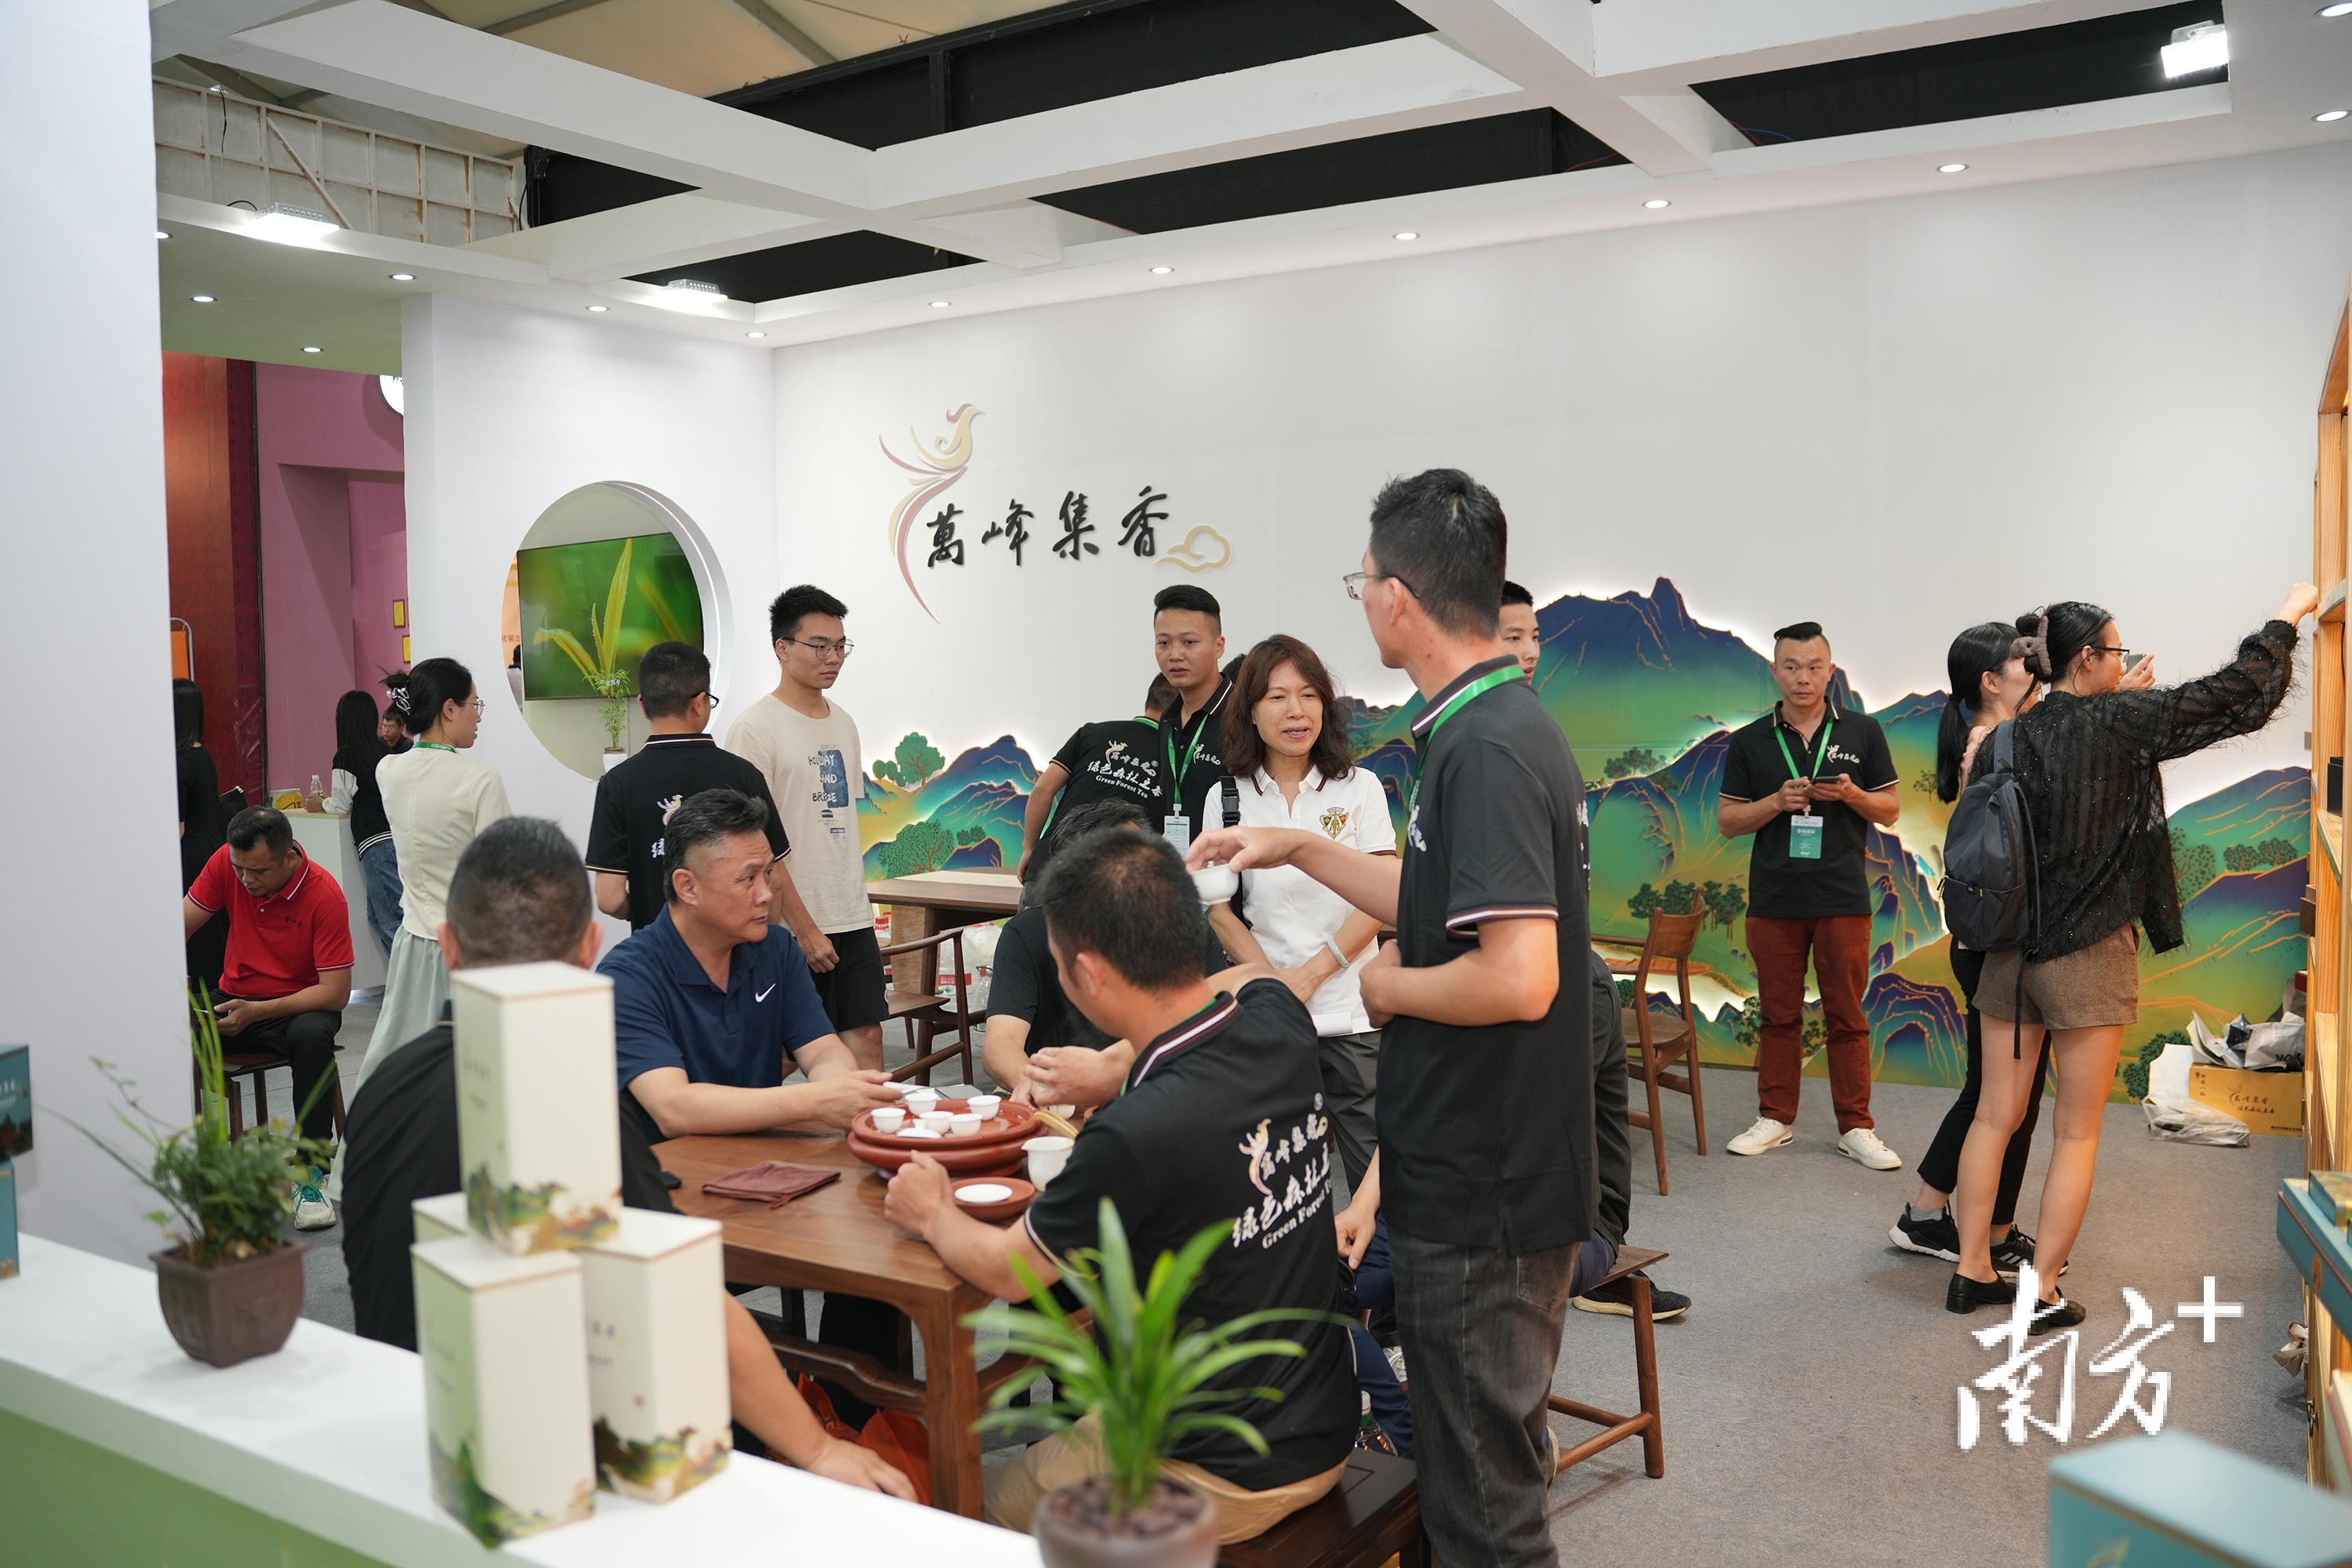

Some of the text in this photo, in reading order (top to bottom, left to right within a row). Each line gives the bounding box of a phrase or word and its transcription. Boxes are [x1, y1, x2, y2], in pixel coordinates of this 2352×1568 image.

[927, 485, 1170, 568] 萬峰集香
[1095, 775, 1149, 798] Green Forest Tea
[1262, 1216, 1298, 1249] Green
[1297, 1189, 1326, 1223] Forest
